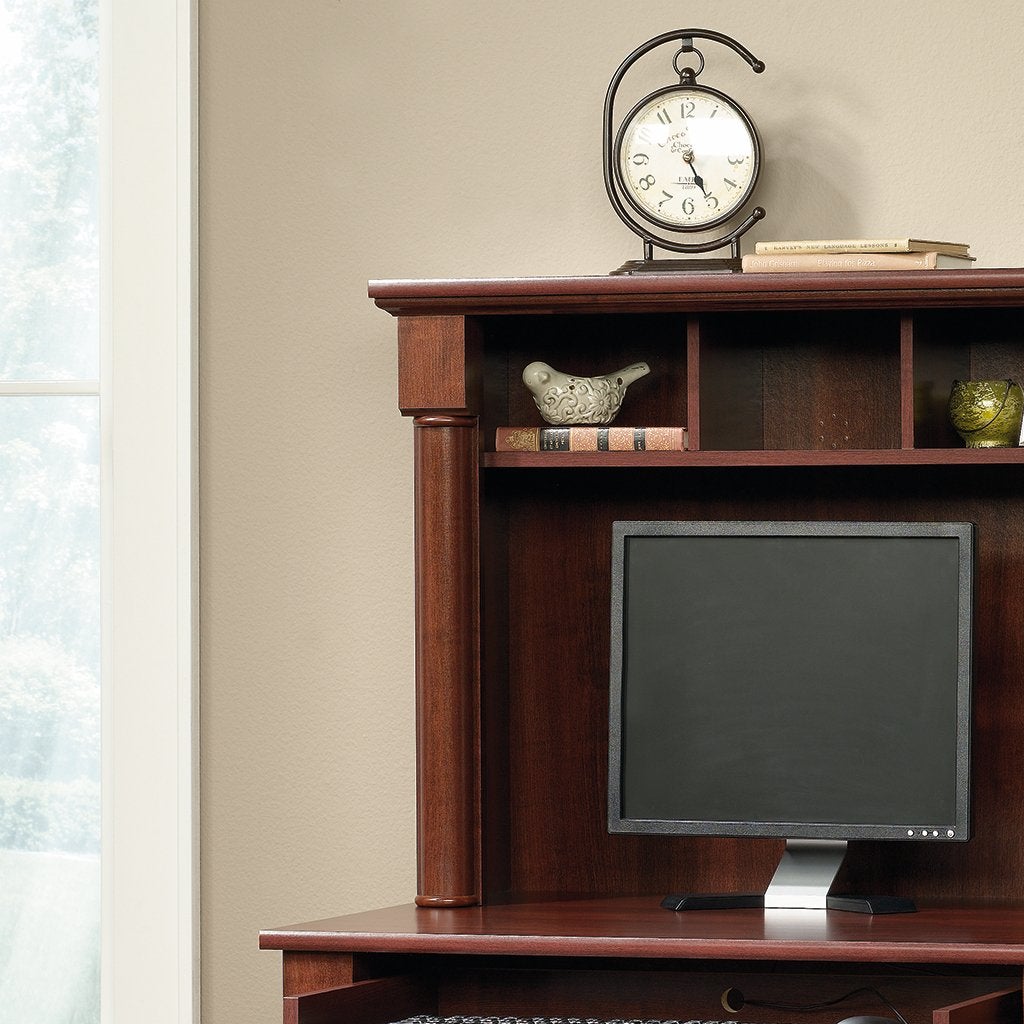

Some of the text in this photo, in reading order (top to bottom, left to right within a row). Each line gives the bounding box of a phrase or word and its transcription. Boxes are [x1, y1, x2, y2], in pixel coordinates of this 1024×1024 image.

[656, 108, 673, 125] 11
[681, 102, 696, 119] 12
[632, 153, 650, 166] 9
[638, 174, 656, 191] 8
[723, 176, 738, 192] 4
[657, 190, 674, 207] 7
[681, 197, 695, 216] 6
[703, 191, 719, 209] 5
